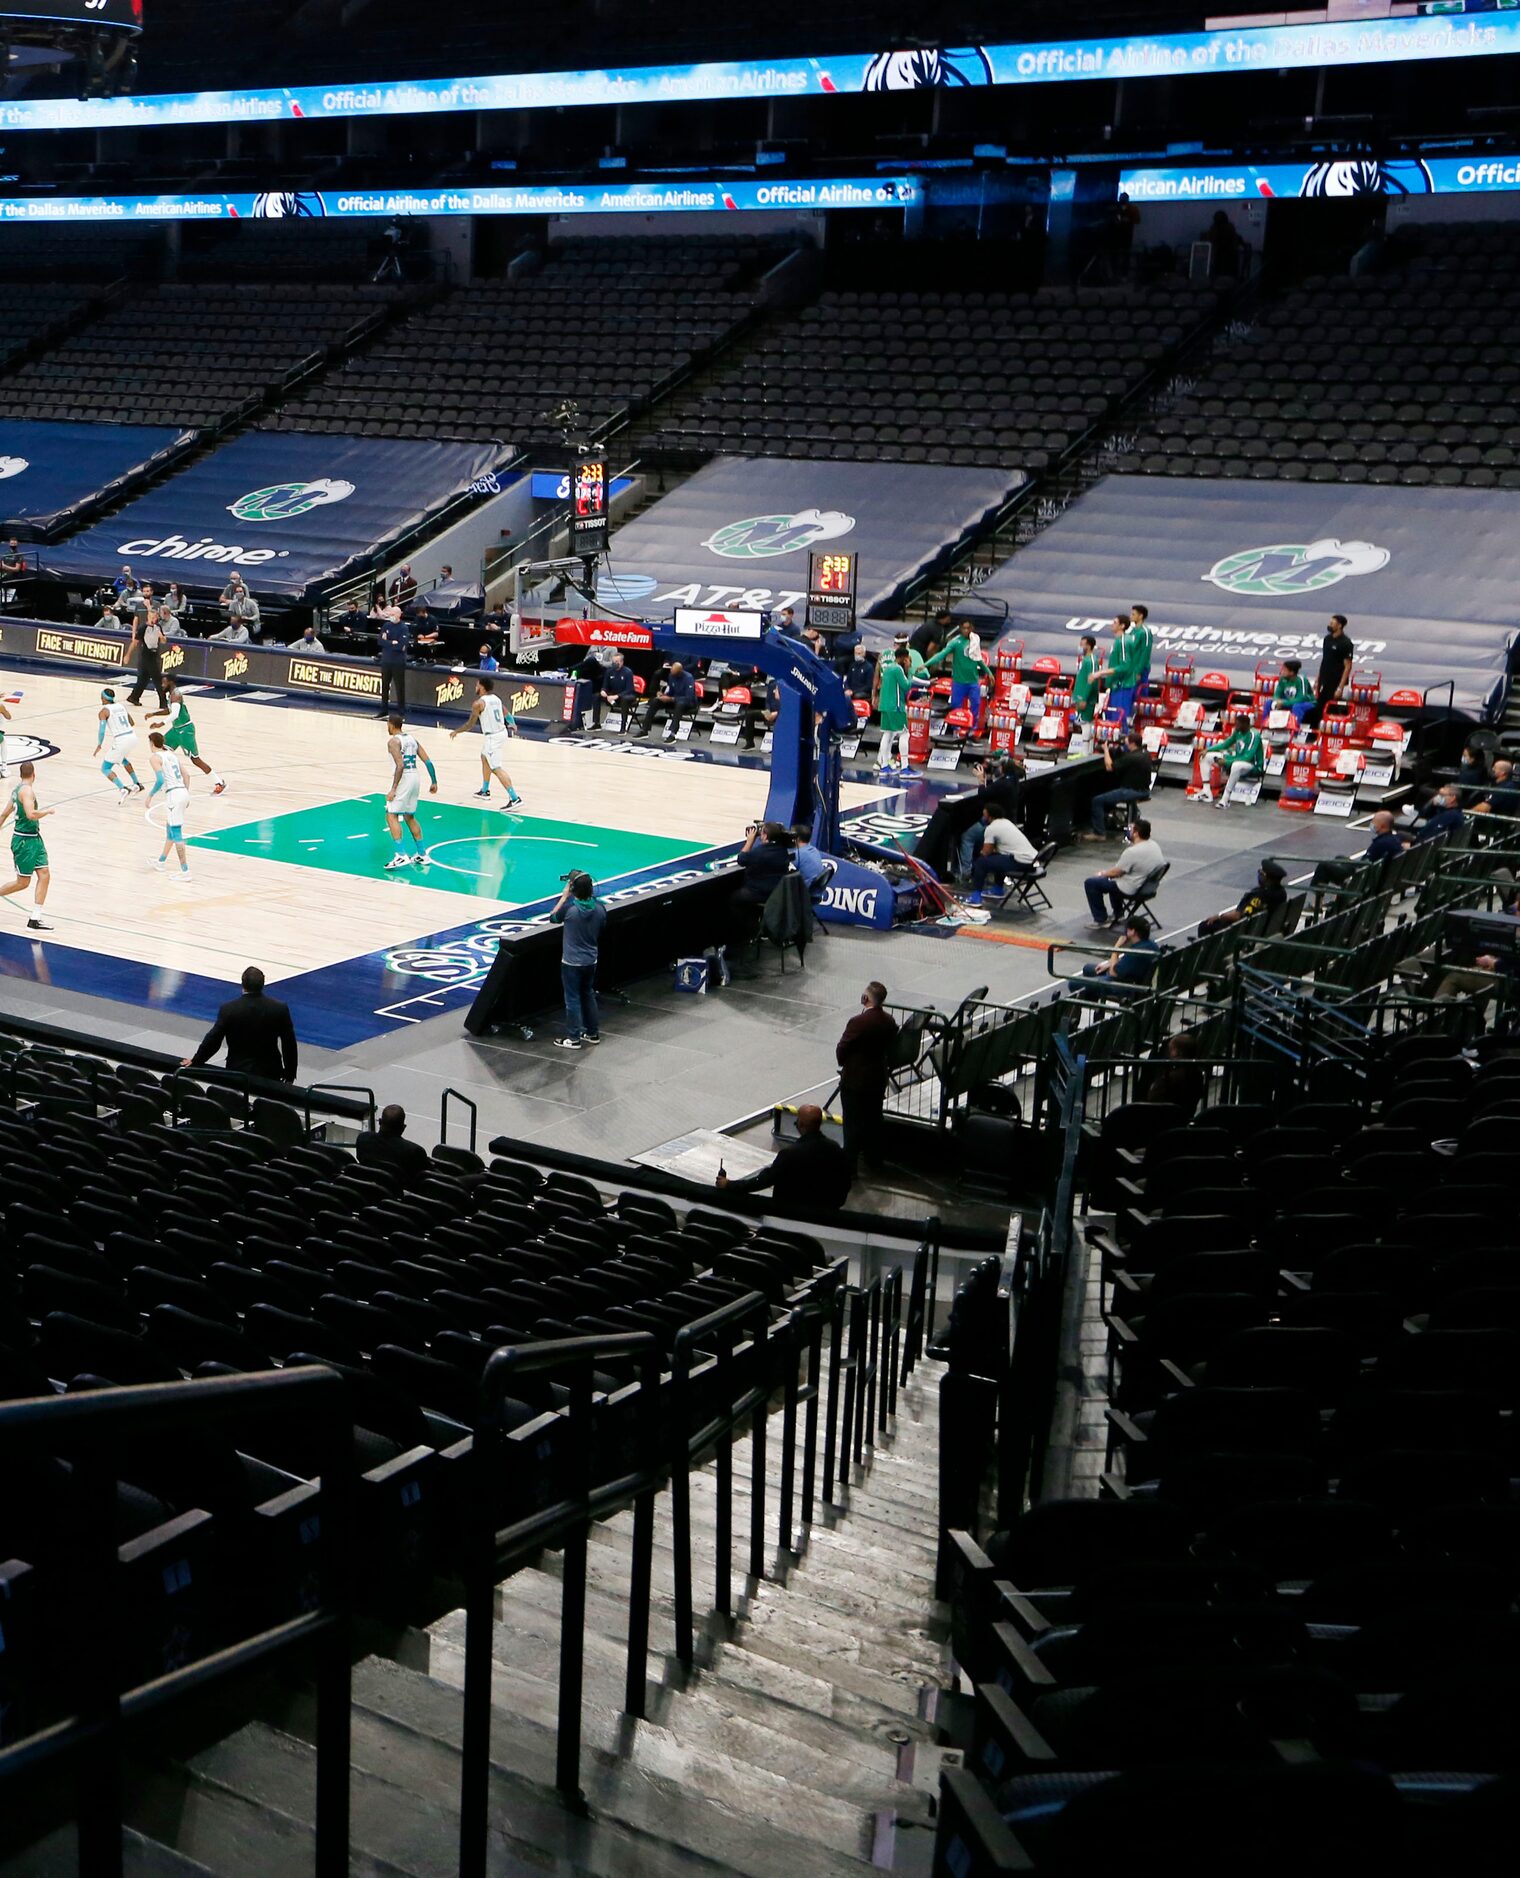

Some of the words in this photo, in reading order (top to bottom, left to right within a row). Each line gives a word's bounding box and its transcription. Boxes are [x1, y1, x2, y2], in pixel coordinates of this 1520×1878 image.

[1017, 47, 1102, 73] Official
[1106, 43, 1186, 69] Airline
[1190, 39, 1220, 65] of
[1224, 37, 1267, 63] the
[742, 69, 808, 89] Airlines
[323, 89, 380, 110] Official
[384, 87, 436, 108] Airline
[440, 86, 460, 104] of
[461, 84, 488, 103] the
[756, 186, 816, 204] Official
[820, 184, 874, 203] Airline
[1182, 176, 1246, 195] Airlines
[135, 201, 183, 216] American
[183, 200, 222, 215] Airlines
[337, 196, 384, 212] Official
[386, 195, 429, 211] Airline
[430, 193, 447, 210] of
[448, 193, 470, 209] the
[473, 193, 513, 209] Dallas
[515, 191, 585, 208] Mavericks
[601, 192, 663, 208] American
[663, 190, 715, 206] Airlines
[5, 202, 26, 217] the
[29, 202, 65, 217] Dallas
[68, 202, 123, 216] Mavericks
[582, 463, 603, 482] 2:33
[584, 517, 607, 529] TISSOT
[116, 534, 276, 566] chime
[822, 555, 850, 573] 2:33
[820, 570, 843, 590] 21
[651, 583, 808, 612] AT&T
[821, 594, 851, 605] TISSOT
[694, 622, 721, 635] Pizza
[722, 622, 741, 634] Hut
[1065, 617, 1115, 633] UT
[40, 633, 62, 652] FACE
[62, 640, 74, 651] THE
[74, 640, 122, 662] INTENSITY
[1155, 637, 1270, 658] Medical
[160, 650, 185, 673] Takis
[223, 657, 249, 681] Takis
[293, 663, 318, 683] FACE
[319, 670, 333, 683] THE
[435, 681, 464, 707] Takis
[510, 690, 540, 716] Takis
[118, 715, 129, 728] 4
[712, 729, 738, 737] GEICO
[548, 736, 695, 760] chime
[930, 756, 958, 764] GEICO
[171, 764, 181, 780] 2
[1317, 799, 1351, 809] GEICO
[819, 886, 878, 920] DING
